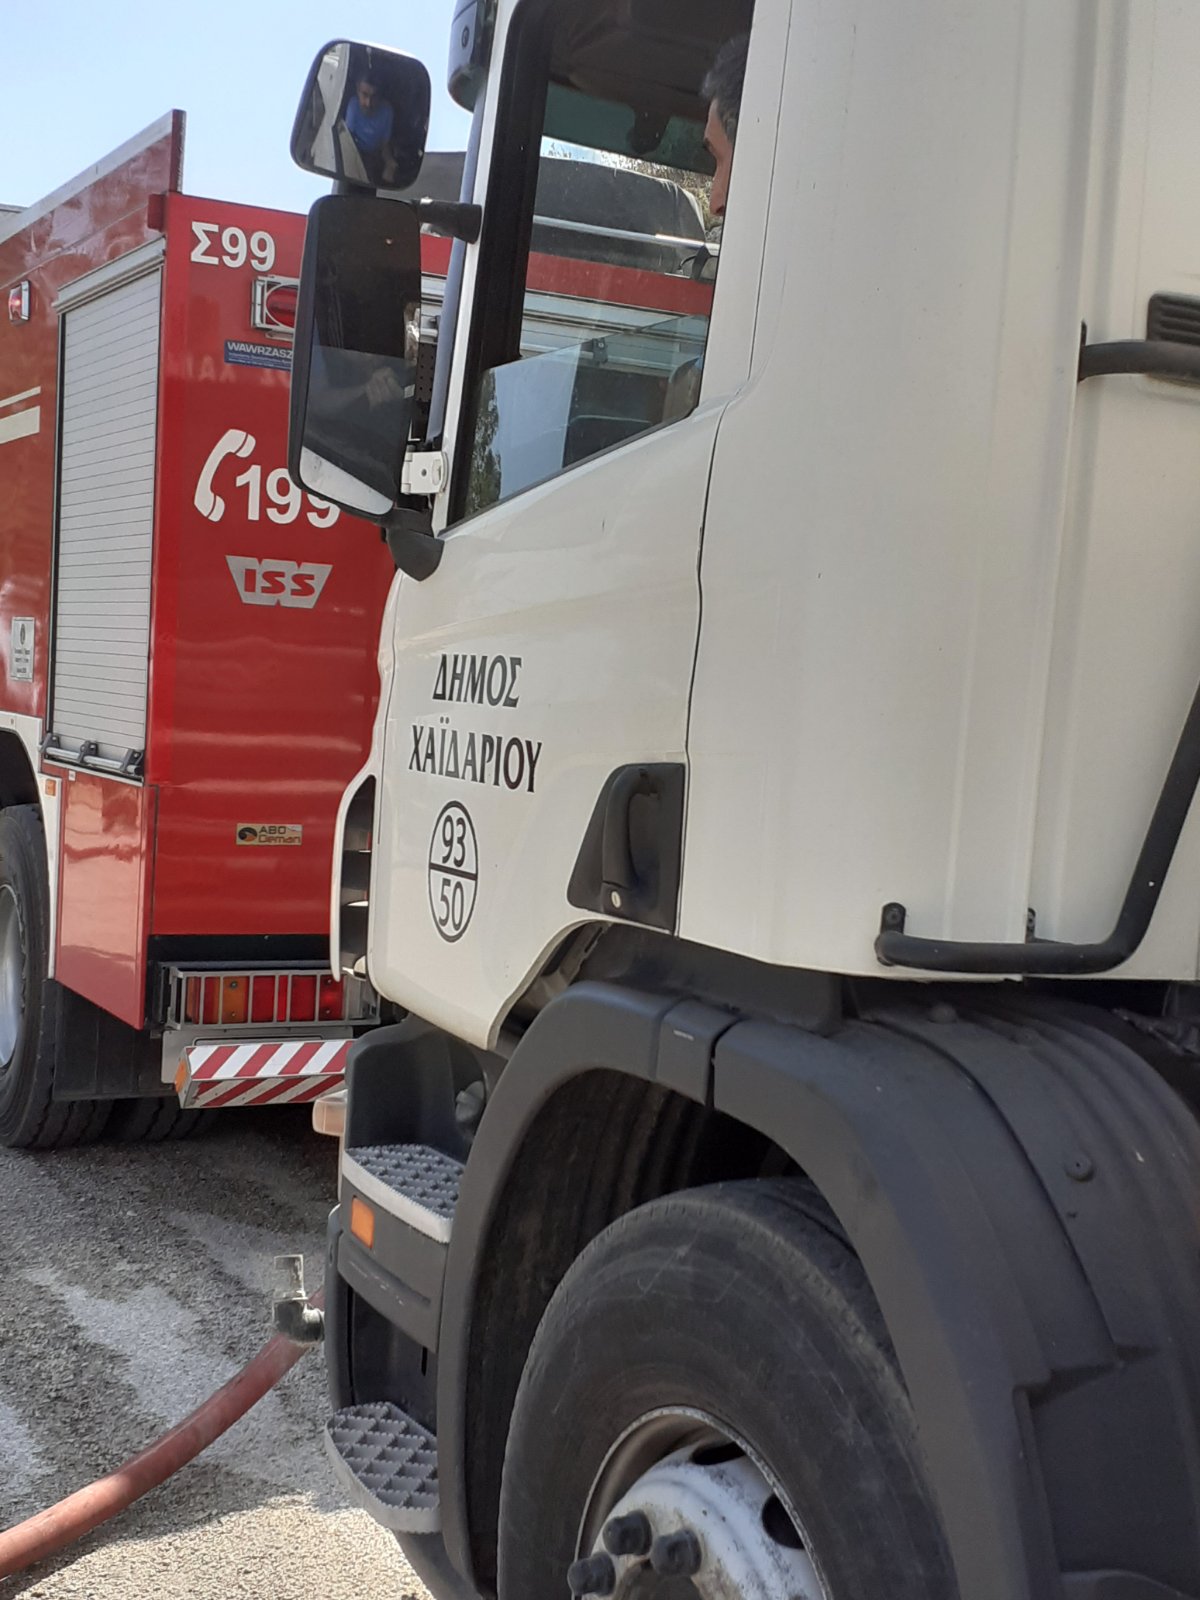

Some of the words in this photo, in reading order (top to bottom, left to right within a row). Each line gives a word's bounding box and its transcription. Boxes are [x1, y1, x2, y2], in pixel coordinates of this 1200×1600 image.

[190, 221, 276, 272] Σ99
[243, 568, 316, 598] ISS
[432, 653, 522, 708] ΔΗΜΟΣ
[408, 716, 542, 793] ΧΑΪΔΑΡΙΟΥ
[441, 814, 467, 868] 93
[438, 877, 465, 931] 50
